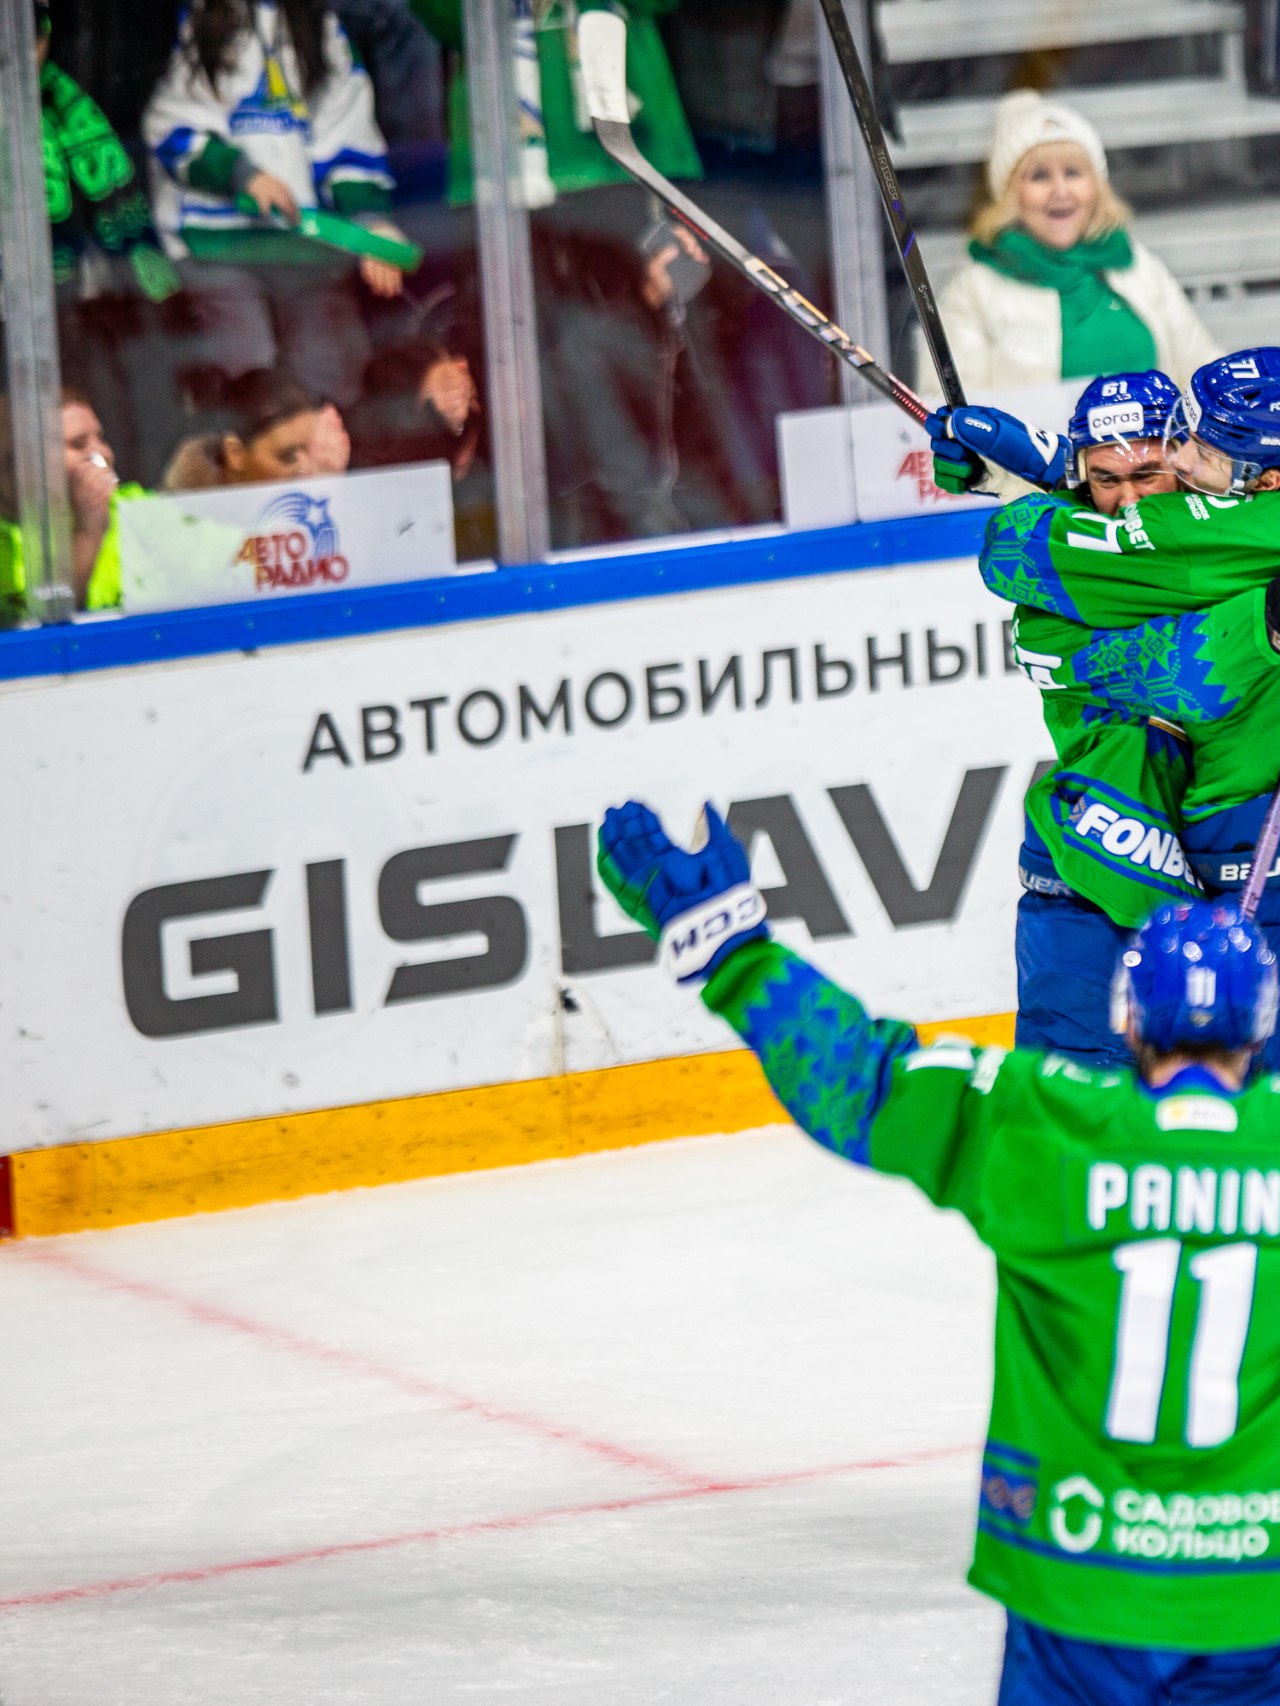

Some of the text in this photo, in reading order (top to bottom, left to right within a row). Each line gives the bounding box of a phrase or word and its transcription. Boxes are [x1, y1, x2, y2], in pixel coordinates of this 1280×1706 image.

[877, 149, 900, 200] TRIGGER
[1102, 380, 1128, 397] 61
[1229, 357, 1261, 379] 77
[1092, 411, 1141, 429] согаз
[1075, 802, 1205, 891] FONB
[120, 759, 1057, 1041] GISLAV
[1186, 964, 1217, 1009] 11
[1105, 1238, 1260, 1448] 11
[1112, 1525, 1271, 1562] КОЛЬЦО
